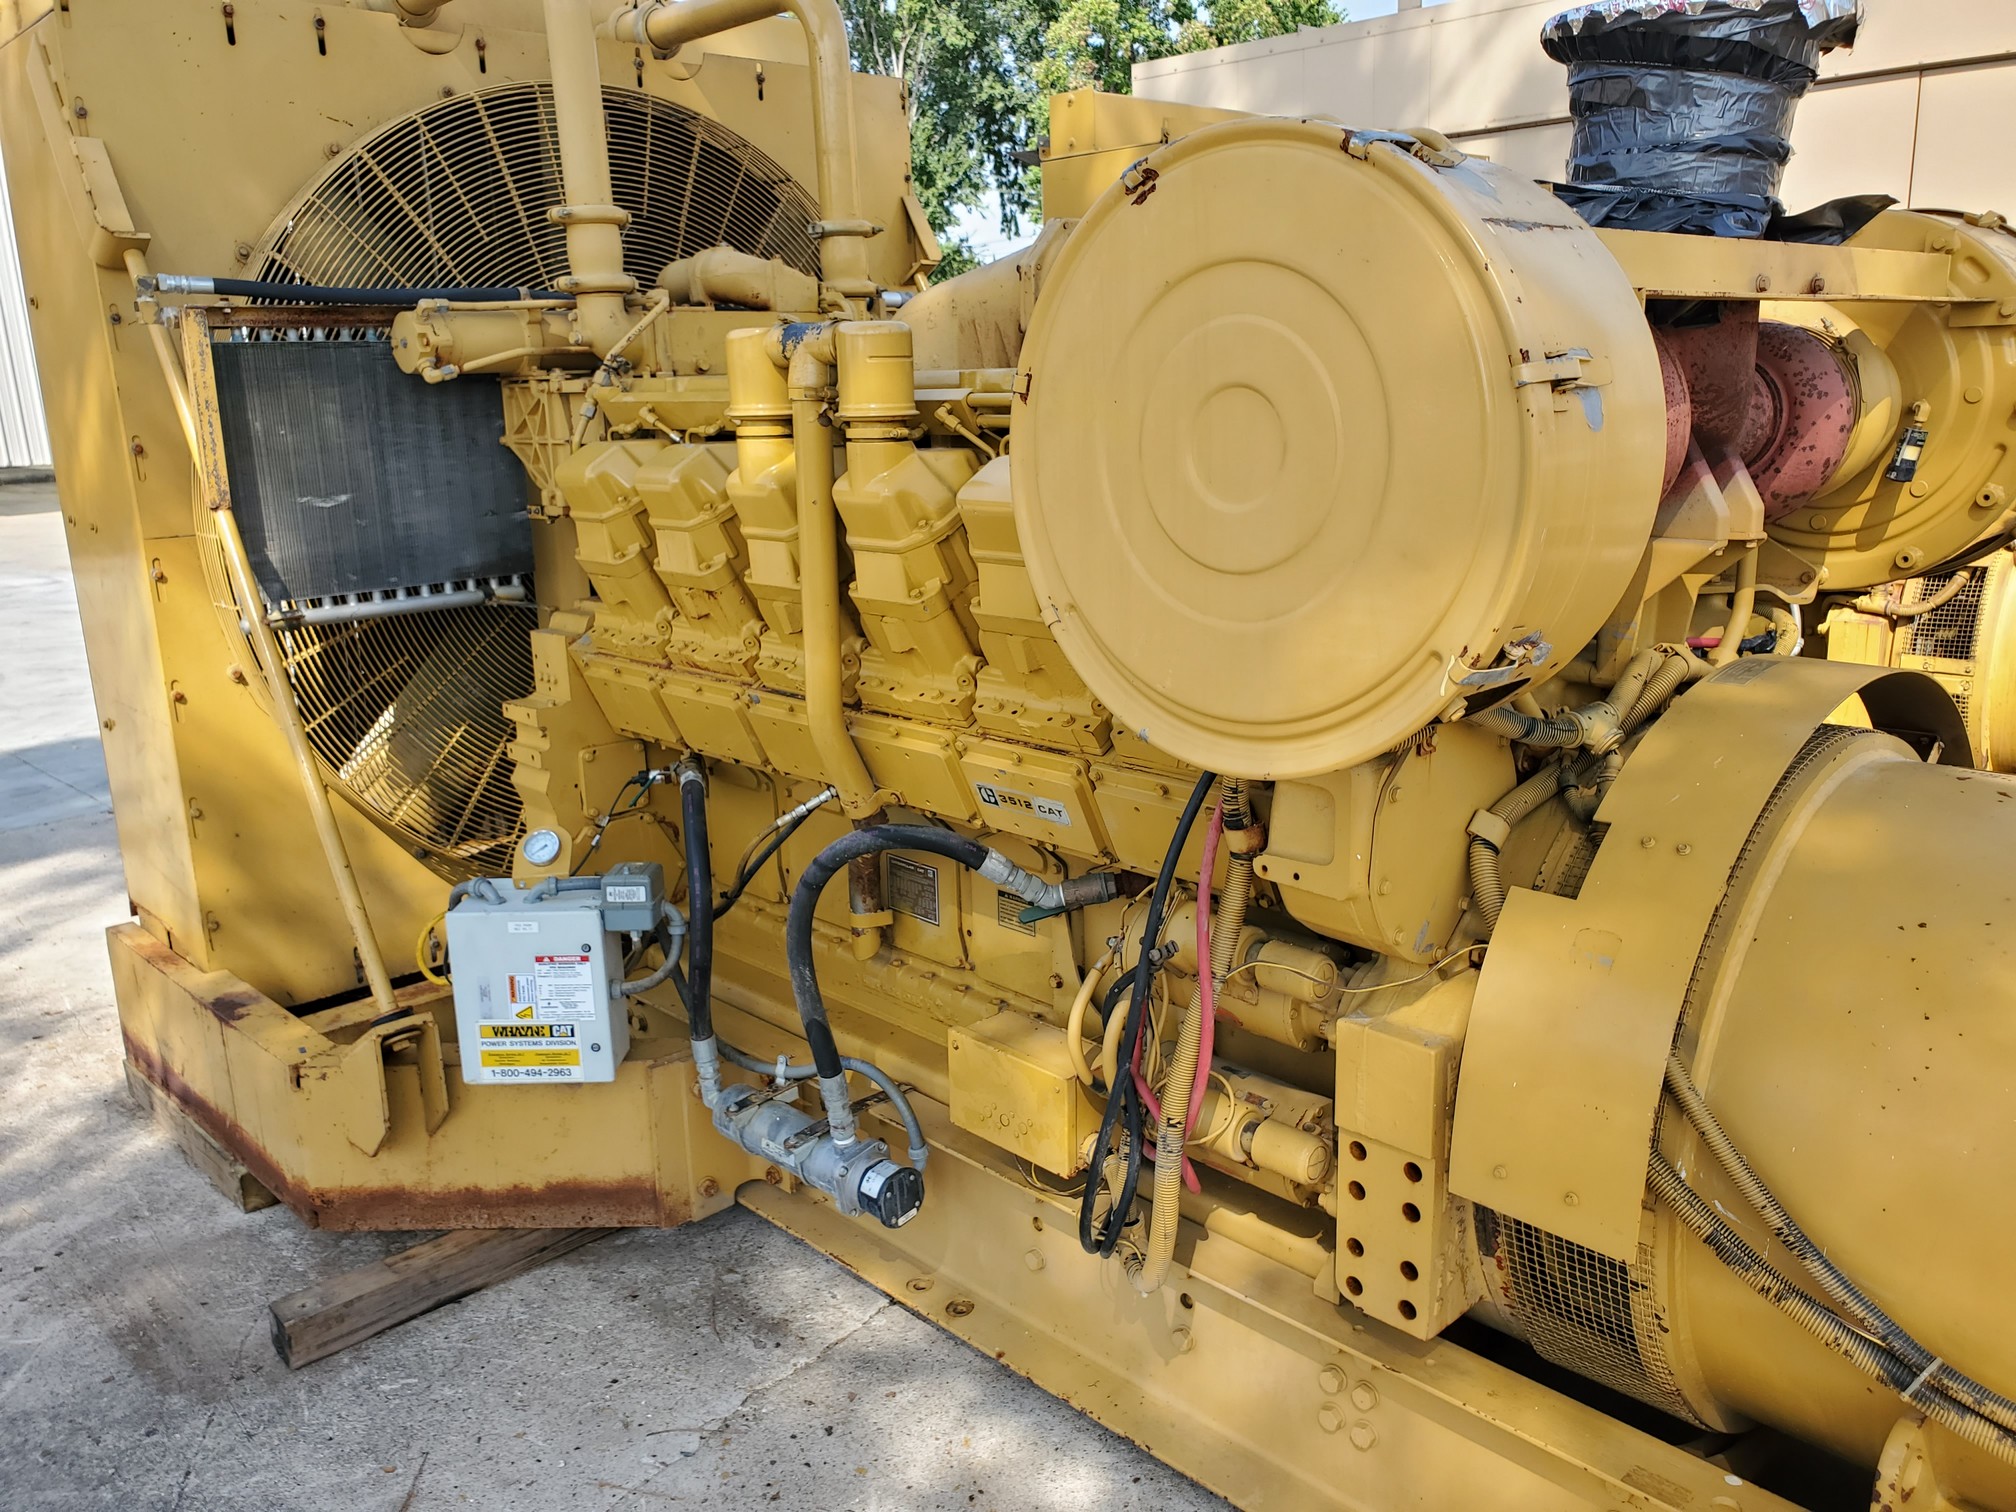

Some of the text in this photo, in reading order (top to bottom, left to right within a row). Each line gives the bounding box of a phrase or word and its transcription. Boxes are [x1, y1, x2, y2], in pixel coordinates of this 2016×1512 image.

[998, 794, 1063, 818] 3512 CAT
[492, 1025, 573, 1037] WHAYNE CAT
[491, 1068, 572, 1078] 1-800-494-2963
